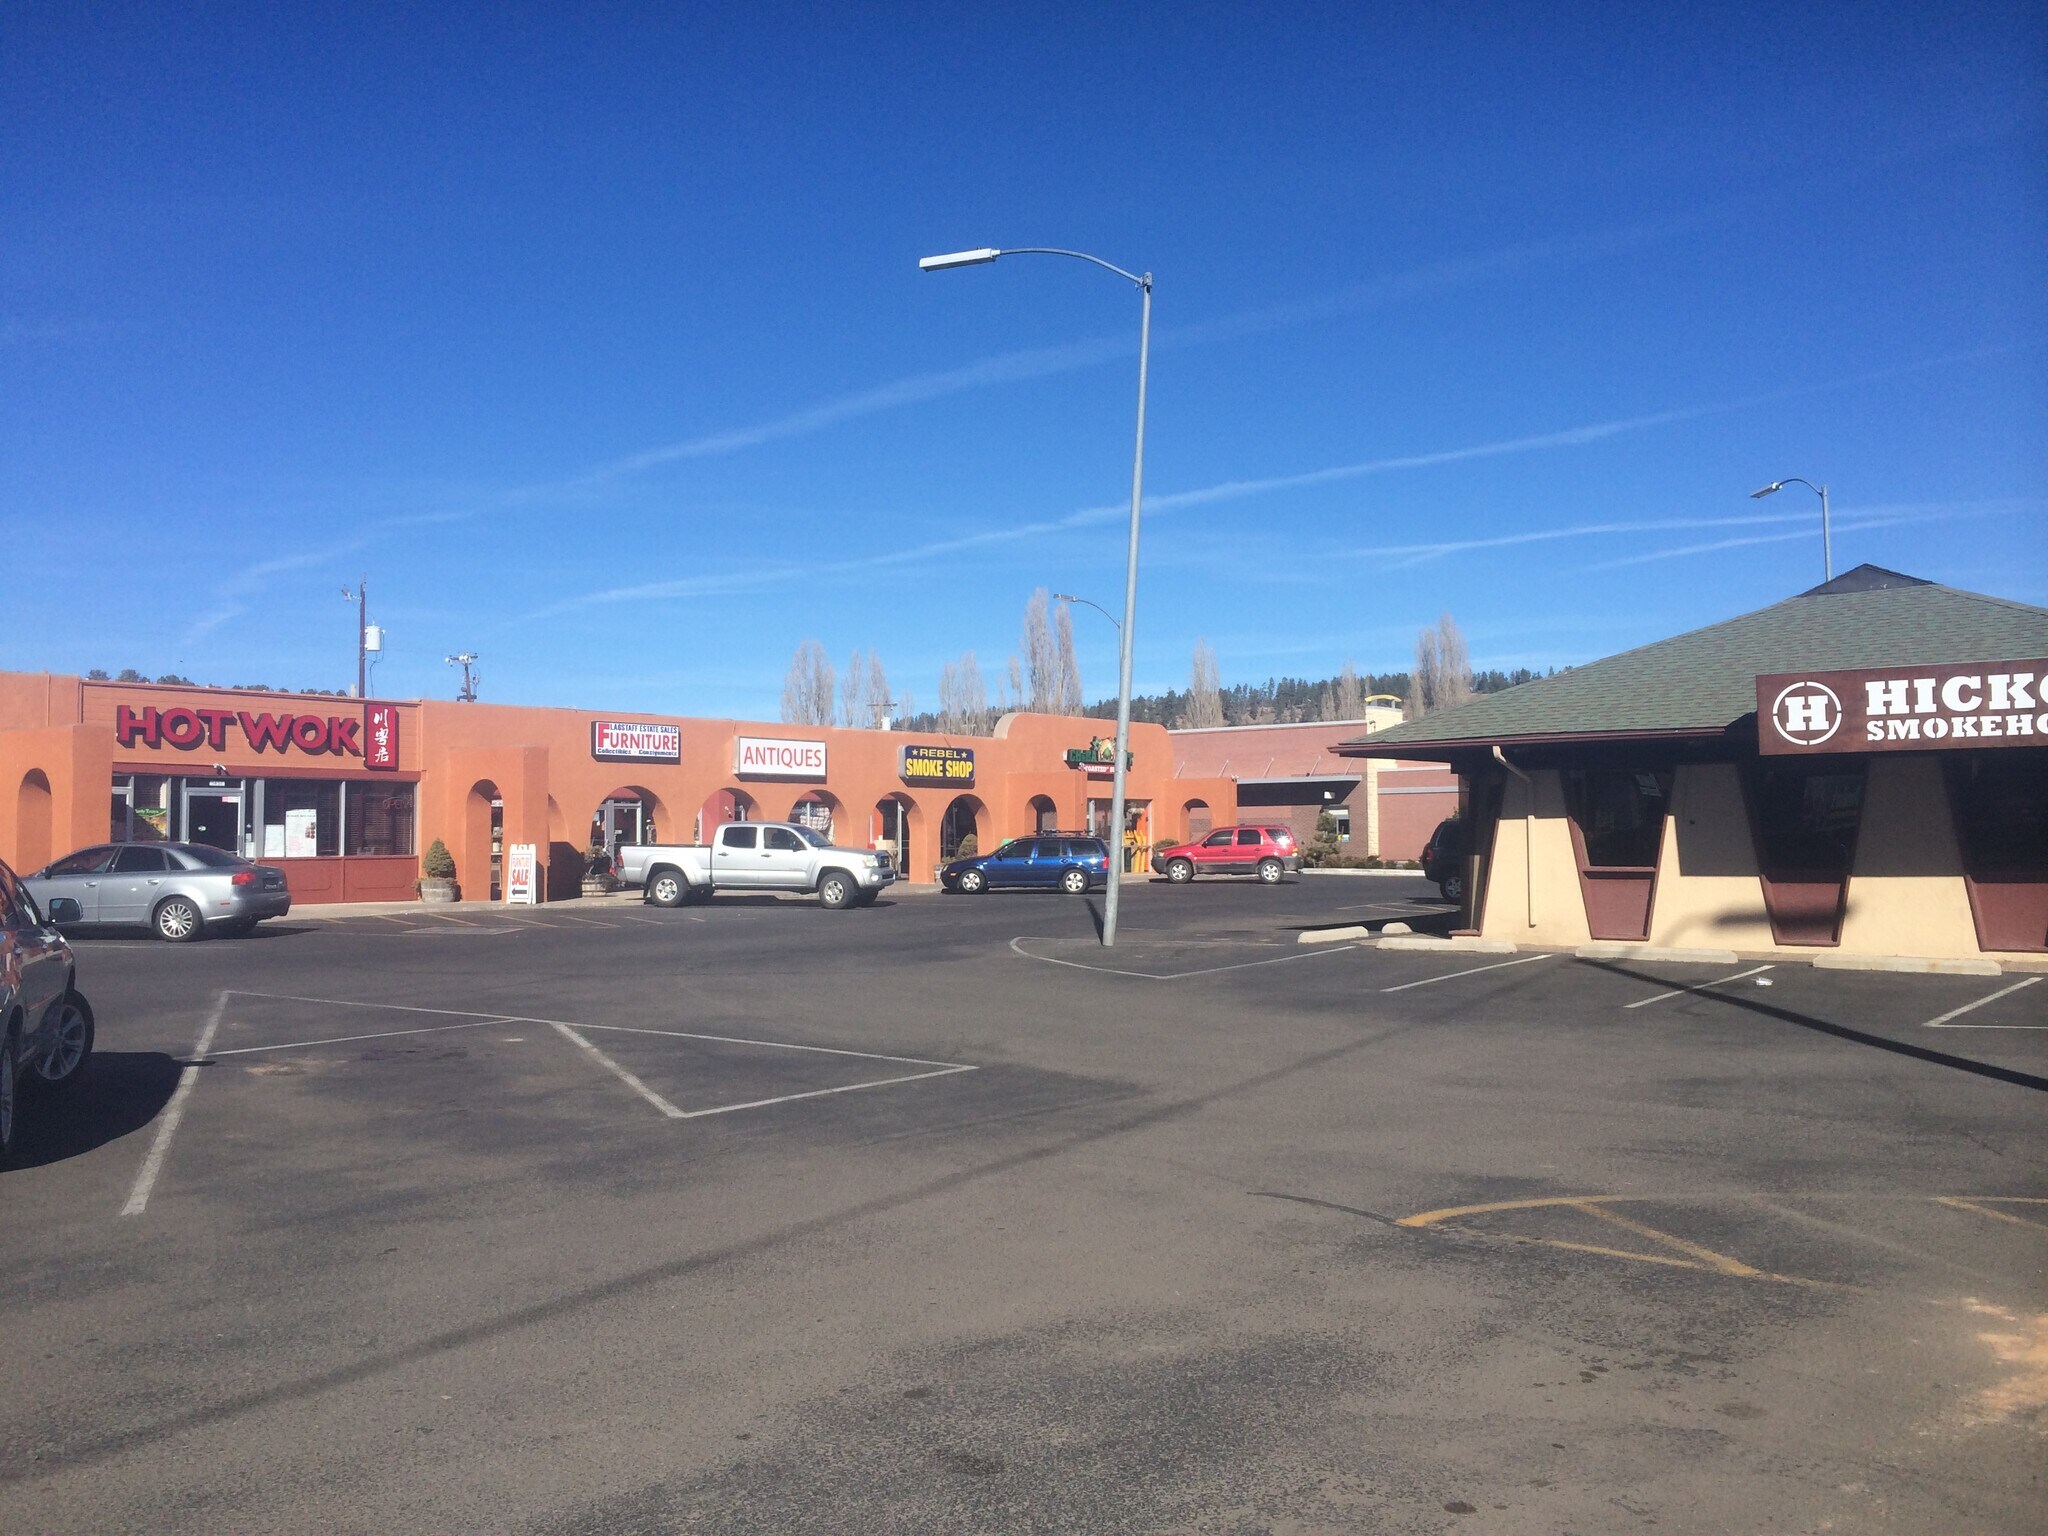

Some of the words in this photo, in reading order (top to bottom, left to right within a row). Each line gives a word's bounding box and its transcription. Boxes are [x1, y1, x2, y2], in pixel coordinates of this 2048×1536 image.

[1865, 673, 2048, 716] HICK
[1784, 695, 1830, 732] H
[117, 705, 235, 749] HOT
[237, 711, 362, 754] WOK
[597, 723, 677, 751] FURNITURE
[640, 724, 659, 733] ESTATE
[660, 726, 677, 734] SALES
[638, 749, 678, 757] Consignments
[743, 746, 822, 768] ANTIQUES
[919, 748, 960, 759] REBEL
[906, 758, 944, 777] SMOKE
[945, 760, 973, 778] SHOP
[511, 869, 529, 886] SALE
